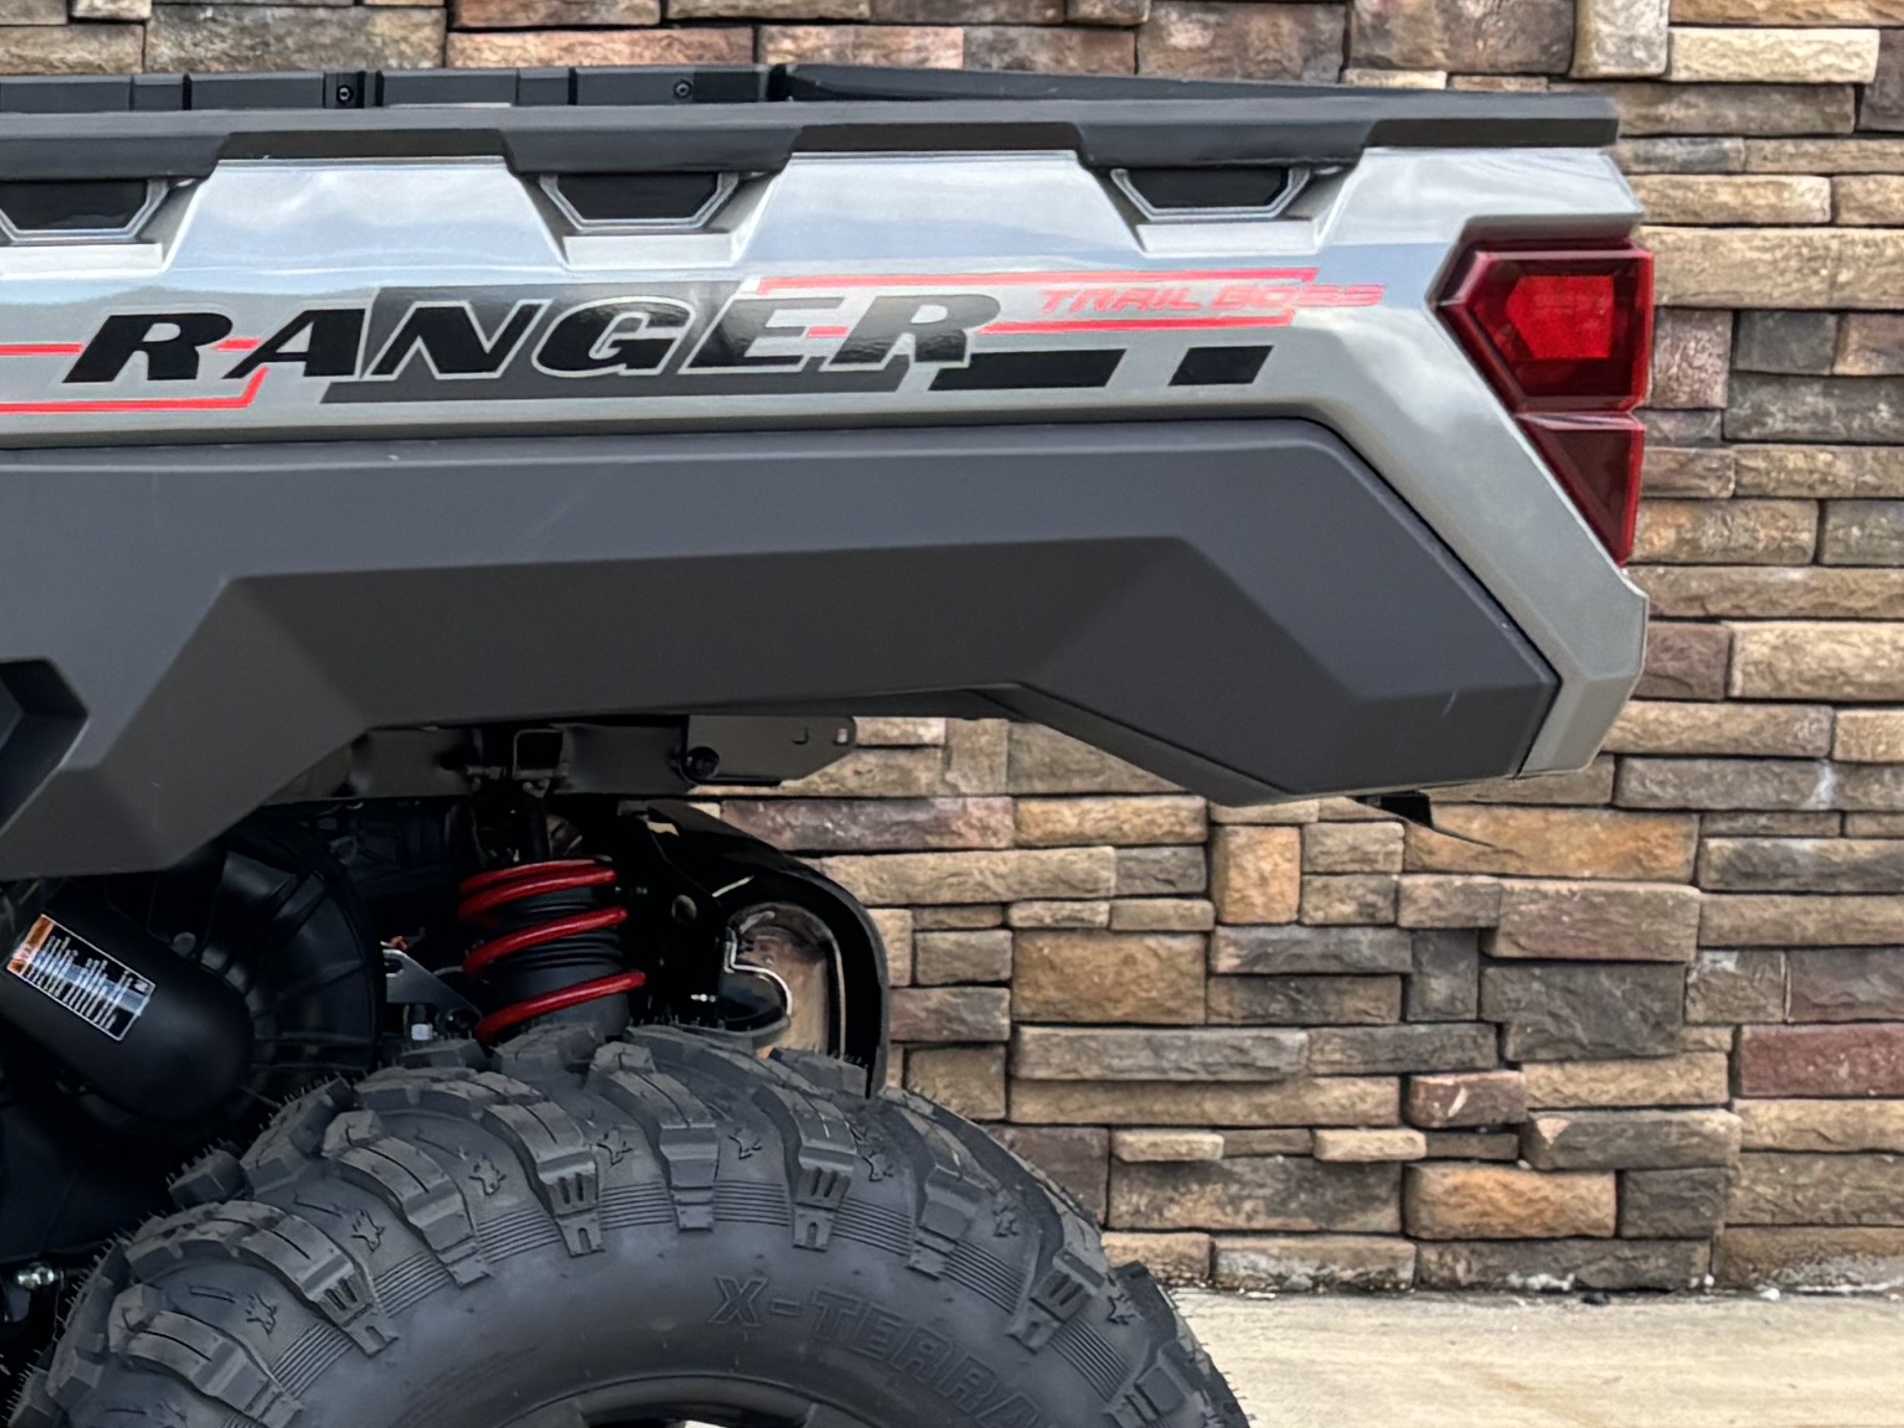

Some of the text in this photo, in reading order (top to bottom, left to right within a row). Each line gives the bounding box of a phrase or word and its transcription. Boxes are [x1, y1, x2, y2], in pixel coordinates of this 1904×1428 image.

[1042, 284, 1387, 314] TRAIL BOSS
[63, 293, 1000, 384] RANGER
